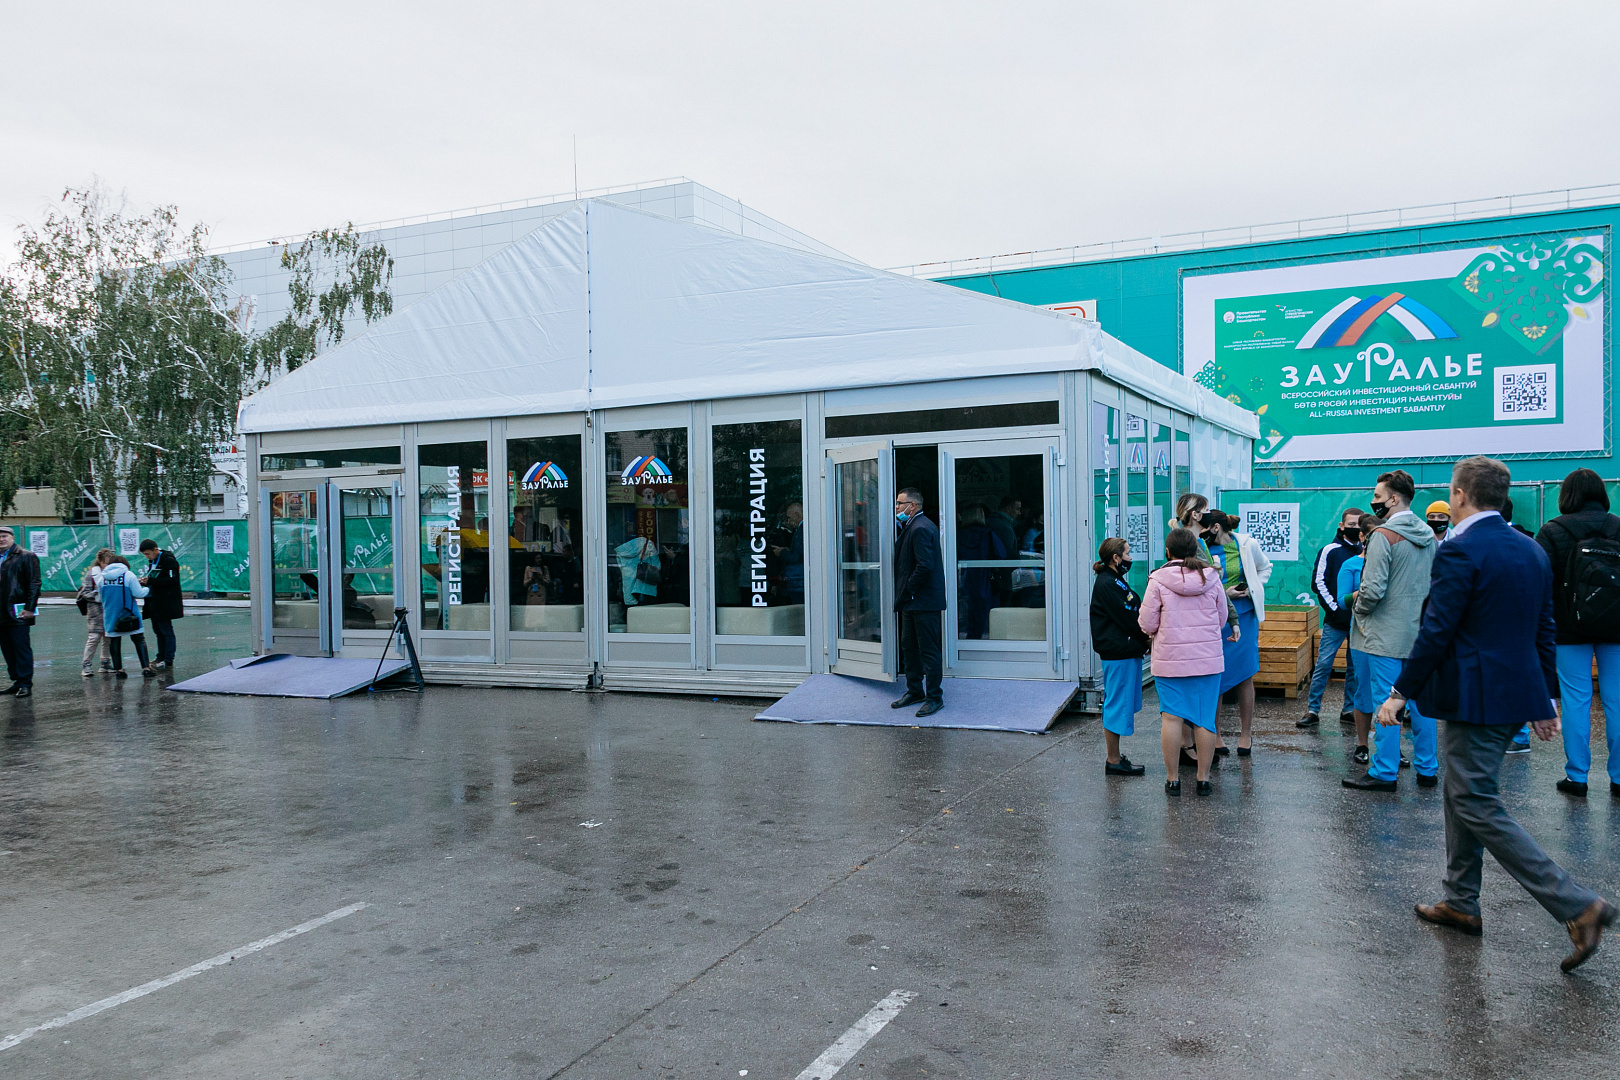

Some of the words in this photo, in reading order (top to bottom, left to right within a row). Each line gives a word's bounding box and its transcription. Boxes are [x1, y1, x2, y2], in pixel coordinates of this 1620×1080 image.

[1280, 343, 1482, 388] ЗАУРАЛЬЕ
[1281, 388, 1351, 399] ВСЕРОССИЙСКИЙ
[1353, 383, 1430, 395] ИНВЕСТИЦИОННЫЙ
[1432, 380, 1477, 391] САБАНТУЙ
[1349, 396, 1406, 406] ИНВЕСТИЦИЯ
[1309, 409, 1352, 418] ALL-RUSSIA
[1354, 406, 1401, 415] INVESTMENT
[1403, 404, 1445, 413] SABANTUY
[521, 475, 569, 490] ЗАУРАЛЬЕ
[621, 470, 673, 486] ЗАУРАЛЬЕ
[1103, 433, 1111, 540] СТРАЦИЯ
[446, 465, 462, 605] РЕГИСТРАЦИЯ
[749, 448, 768, 607] РЕГИСТРАЦИЯ
[45, 539, 88, 579] ЗАУРАЛЬЕ
